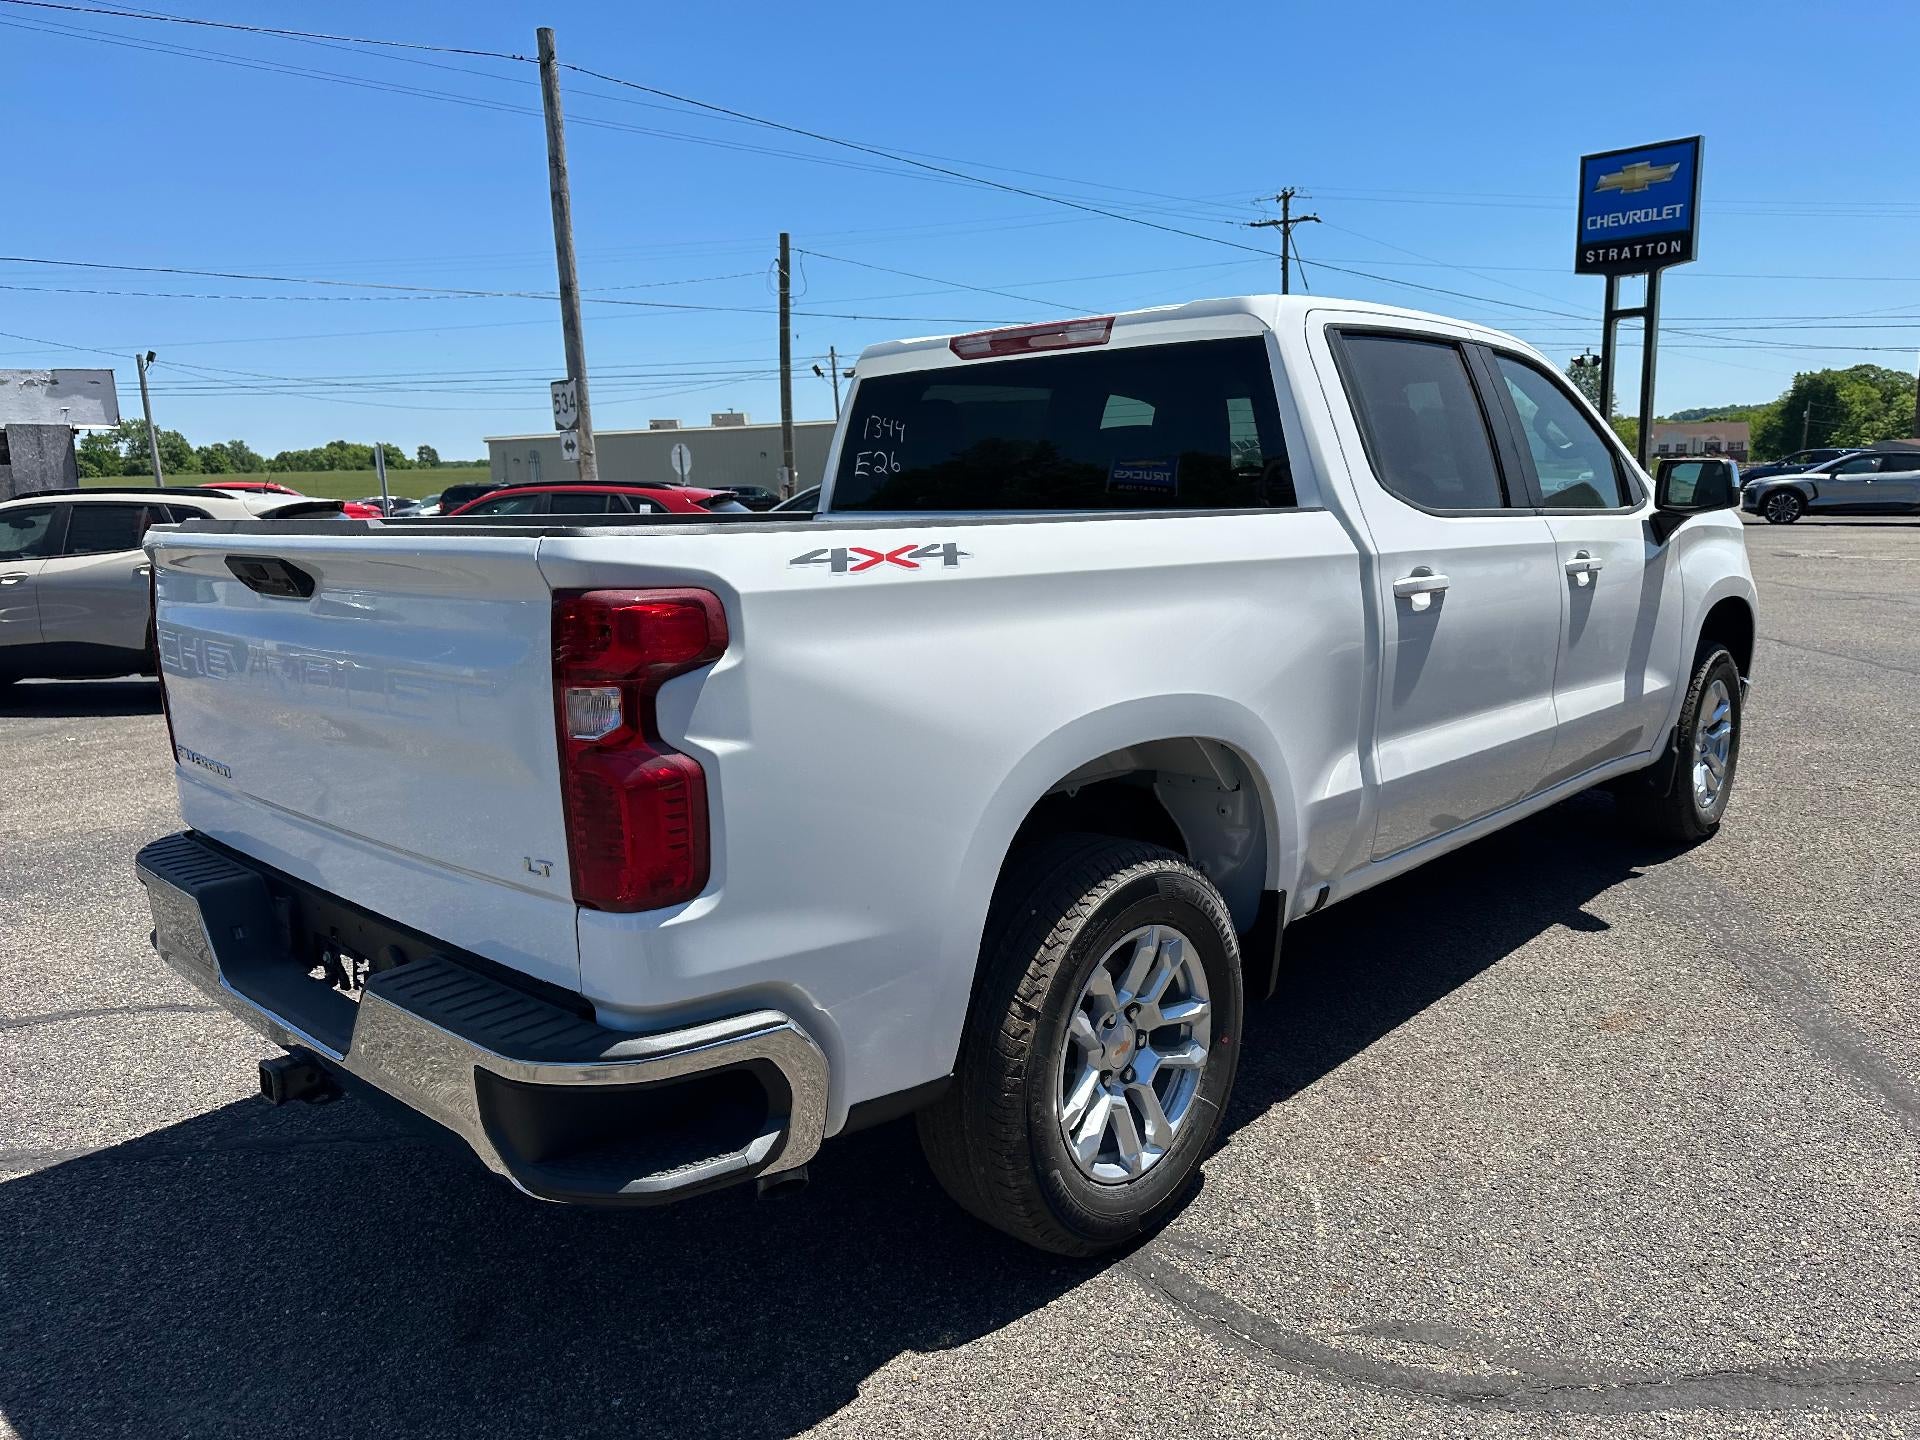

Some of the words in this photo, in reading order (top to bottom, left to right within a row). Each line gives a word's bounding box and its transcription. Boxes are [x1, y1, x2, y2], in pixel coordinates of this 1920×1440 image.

[1586, 204, 1684, 230] CHEVROLET
[1585, 240, 1681, 263] STRATTON
[553, 390, 577, 415] 534
[864, 415, 906, 443] 1344
[854, 451, 901, 477] E26
[523, 856, 554, 878] LT
[1184, 885, 1238, 959] MICHELIN
